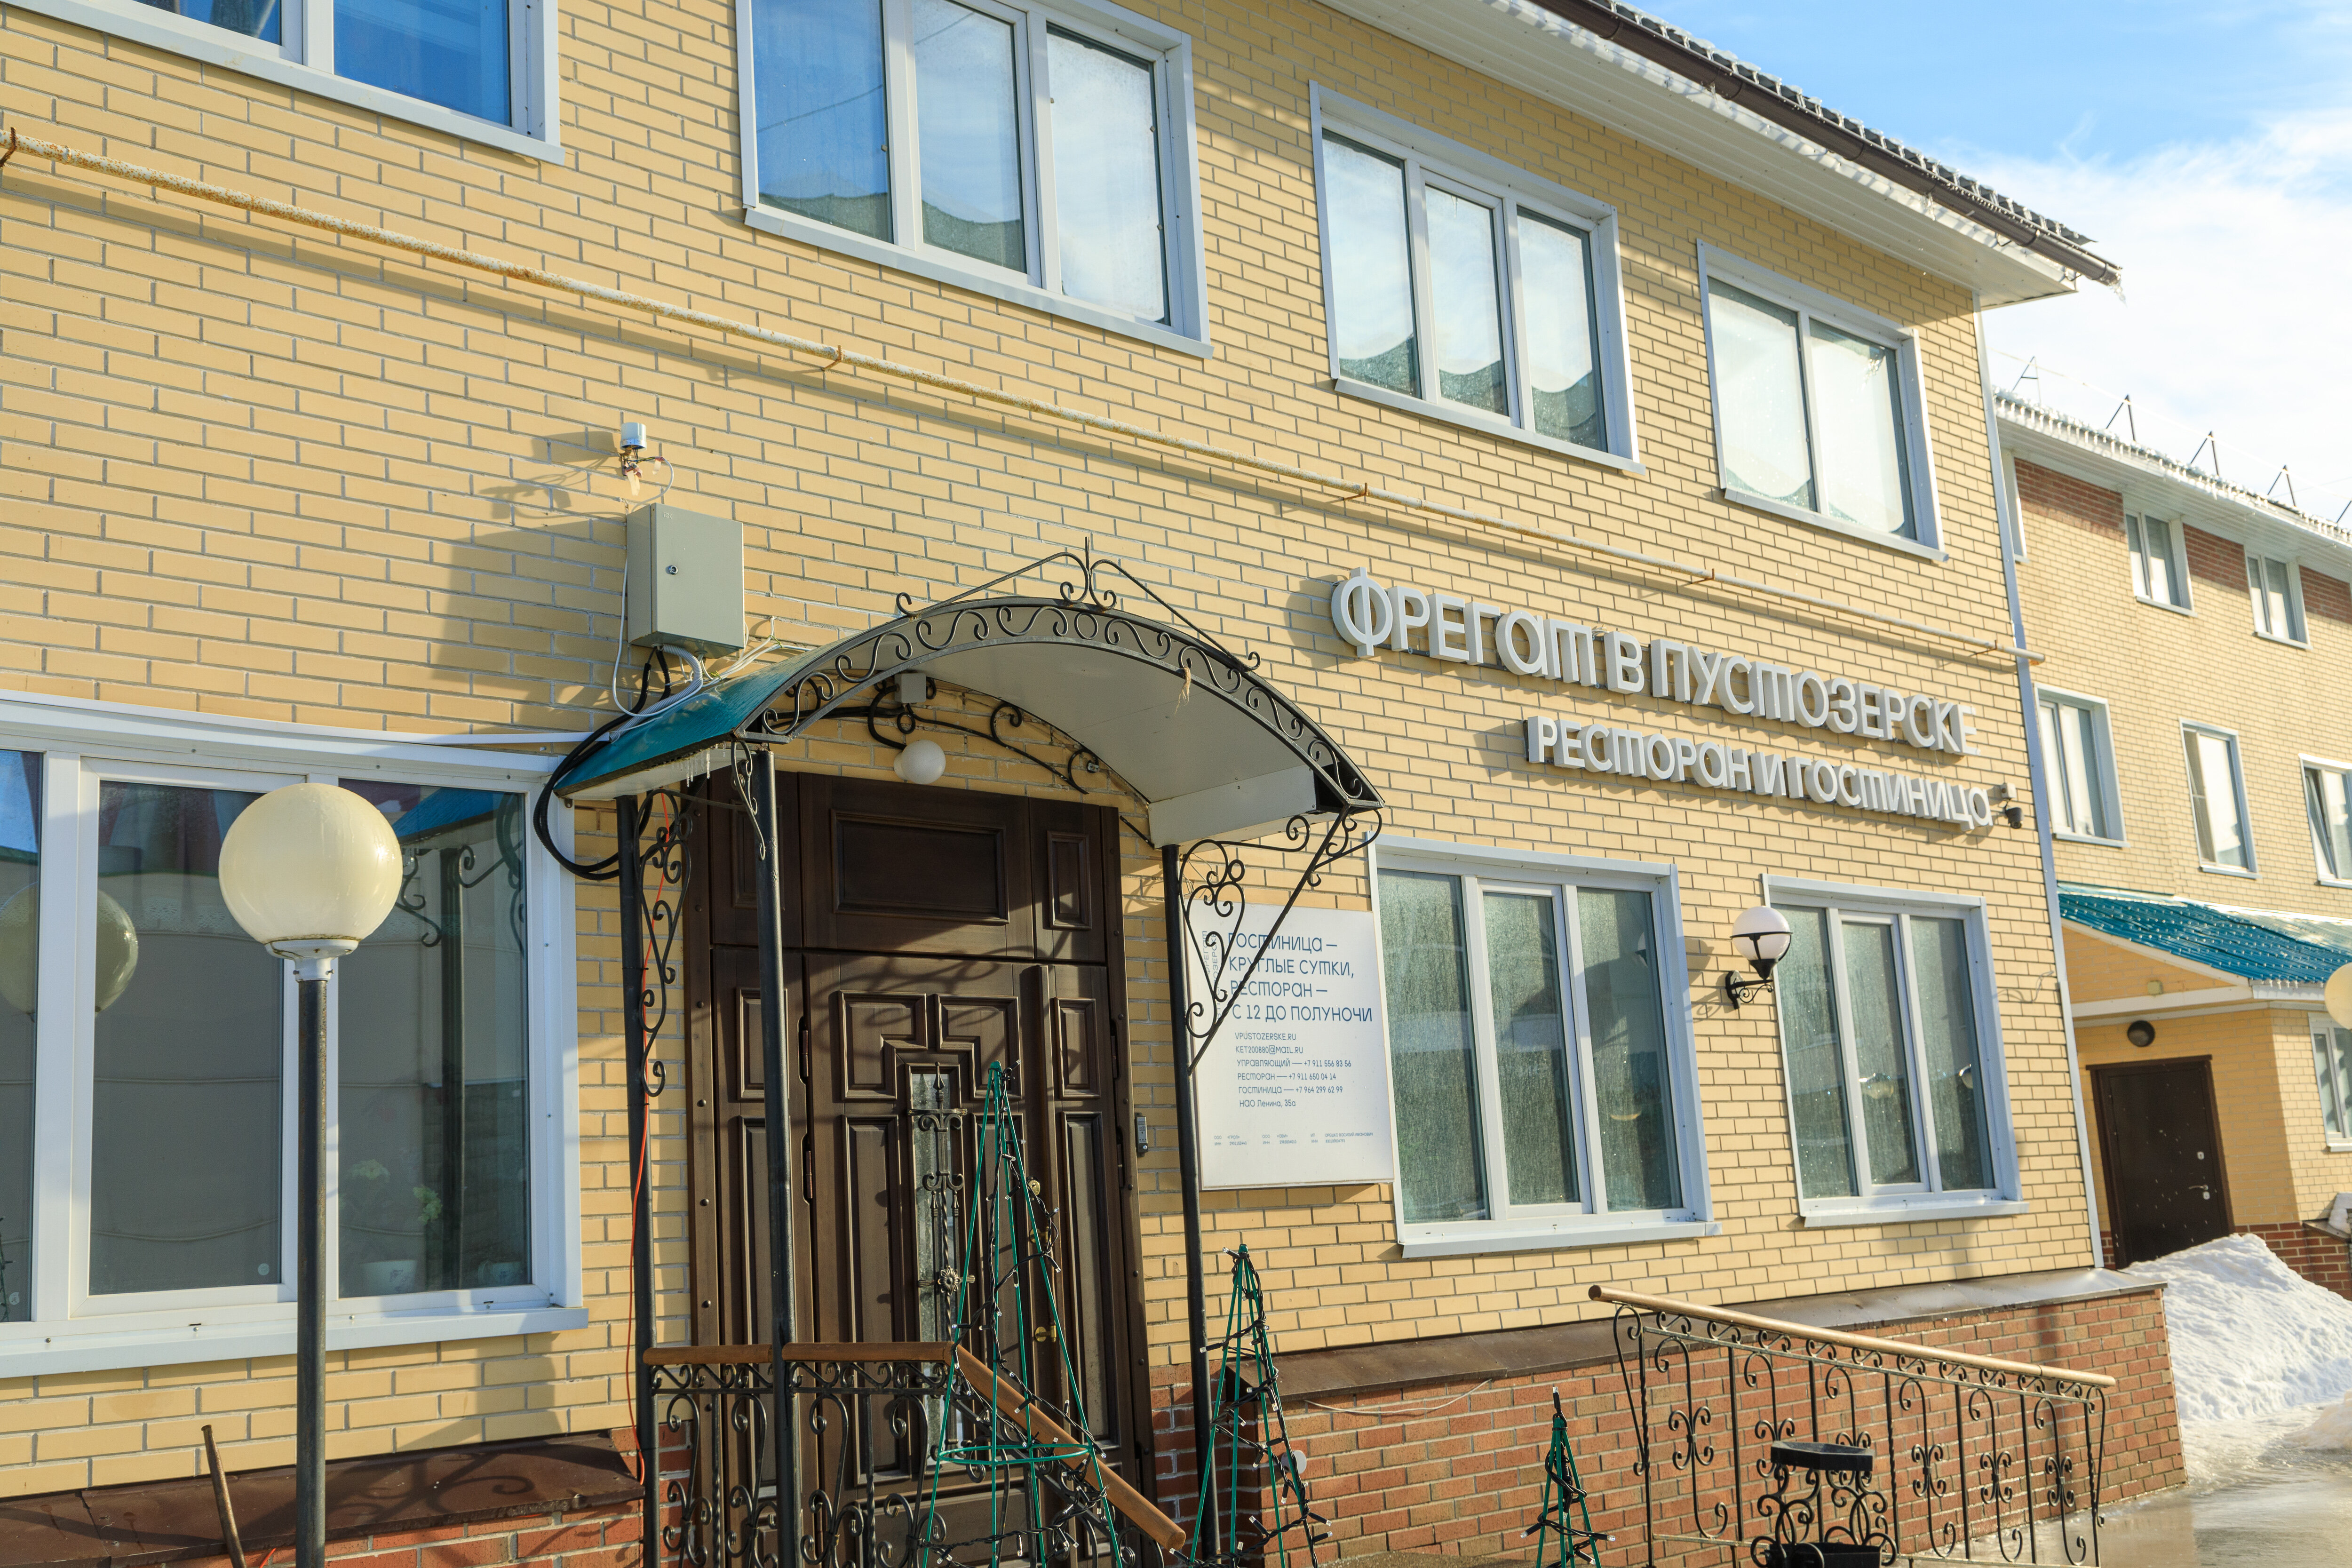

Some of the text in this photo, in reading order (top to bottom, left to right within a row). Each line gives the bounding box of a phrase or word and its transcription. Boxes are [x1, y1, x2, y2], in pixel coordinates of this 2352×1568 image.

[1331, 566, 1980, 756] ФРЕГАТ В ПУСТОЗЕРСКЕ
[1527, 716, 1993, 831] РЕСТОРАН И ГОСТИНИЦА
[1299, 960, 1354, 978] СУТКИ,
[1232, 1004, 1372, 1022] С 12 ДО ПОЛУНОЧИ
[1237, 1058, 1290, 1068] УПРАВЛЯЮЩИЙ
